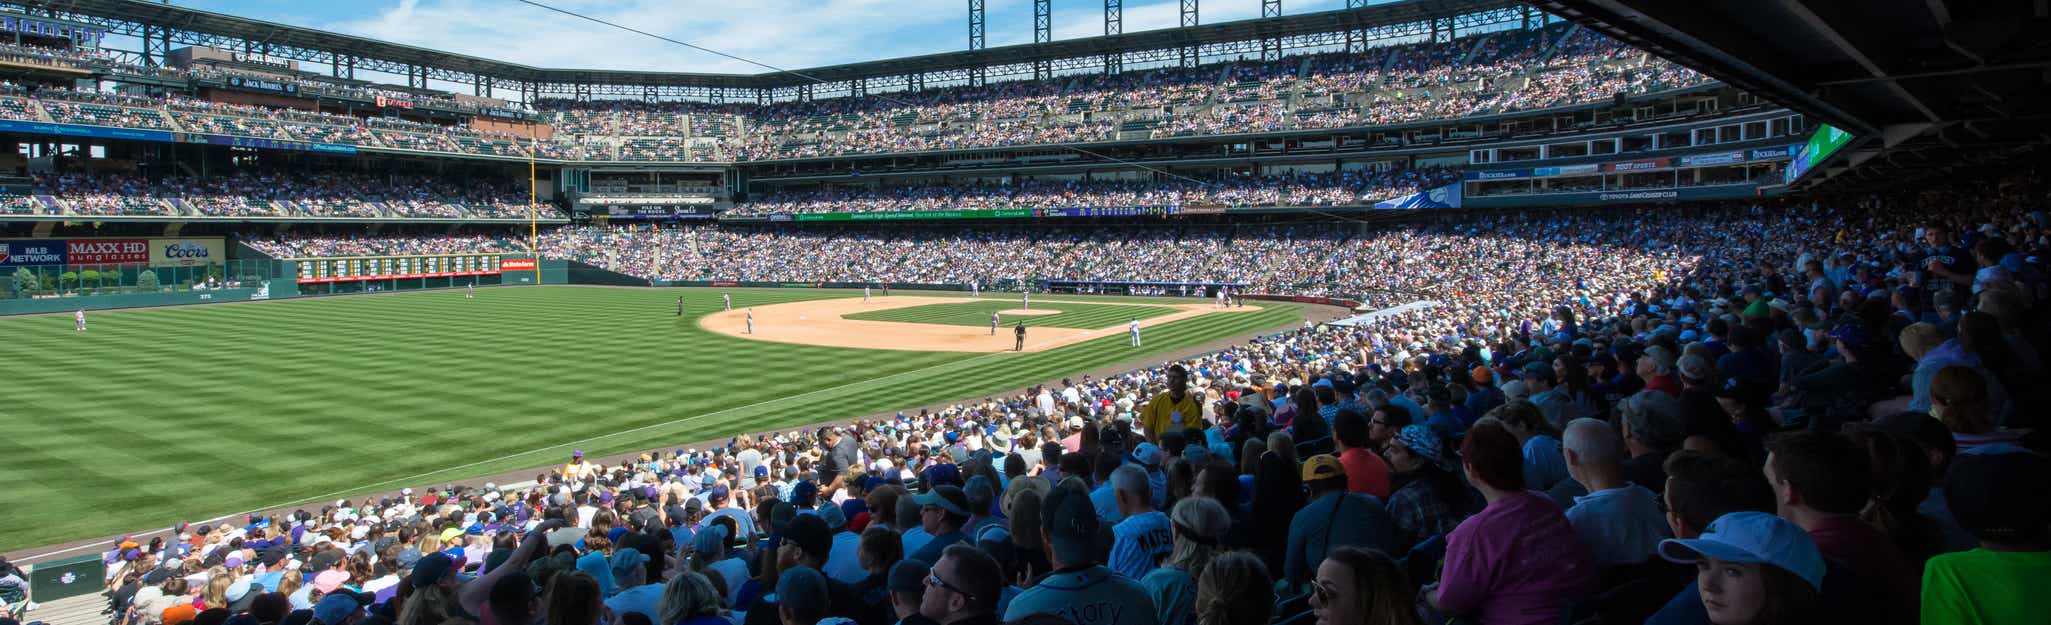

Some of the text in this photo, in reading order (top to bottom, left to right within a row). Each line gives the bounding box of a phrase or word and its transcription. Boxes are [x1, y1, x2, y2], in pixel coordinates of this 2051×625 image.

[25, 247, 48, 255] MLB
[70, 242, 146, 254] MAXX HD
[165, 244, 209, 258] Coors
[10, 254, 61, 263] NETWORK
[70, 253, 146, 261] sunglasses
